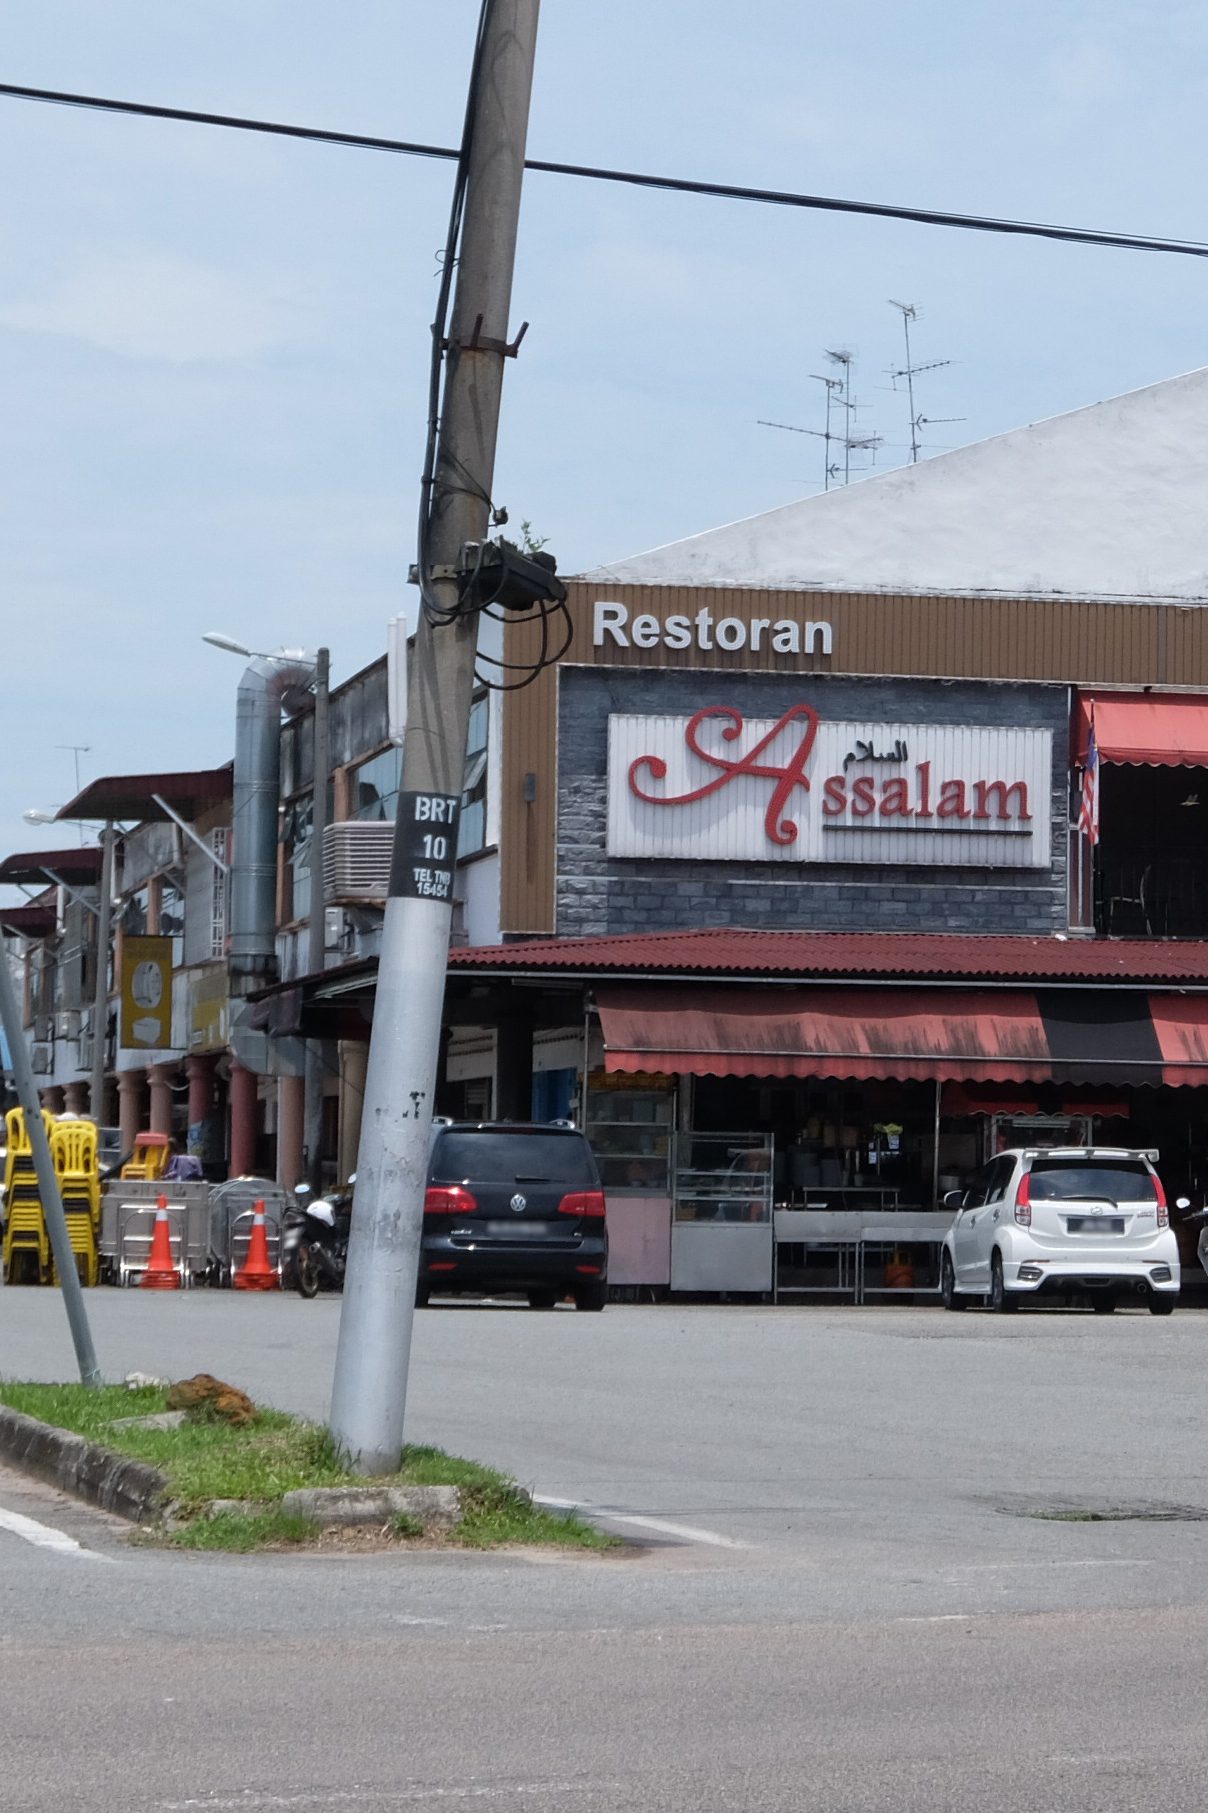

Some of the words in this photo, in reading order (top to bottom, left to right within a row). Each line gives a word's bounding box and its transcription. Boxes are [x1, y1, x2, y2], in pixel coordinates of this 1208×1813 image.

[592, 600, 834, 655] Restoran
[628, 702, 1033, 846] Assalam
[414, 795, 457, 824] BRT
[423, 834, 447, 860] 10
[413, 868, 432, 882] TEL
